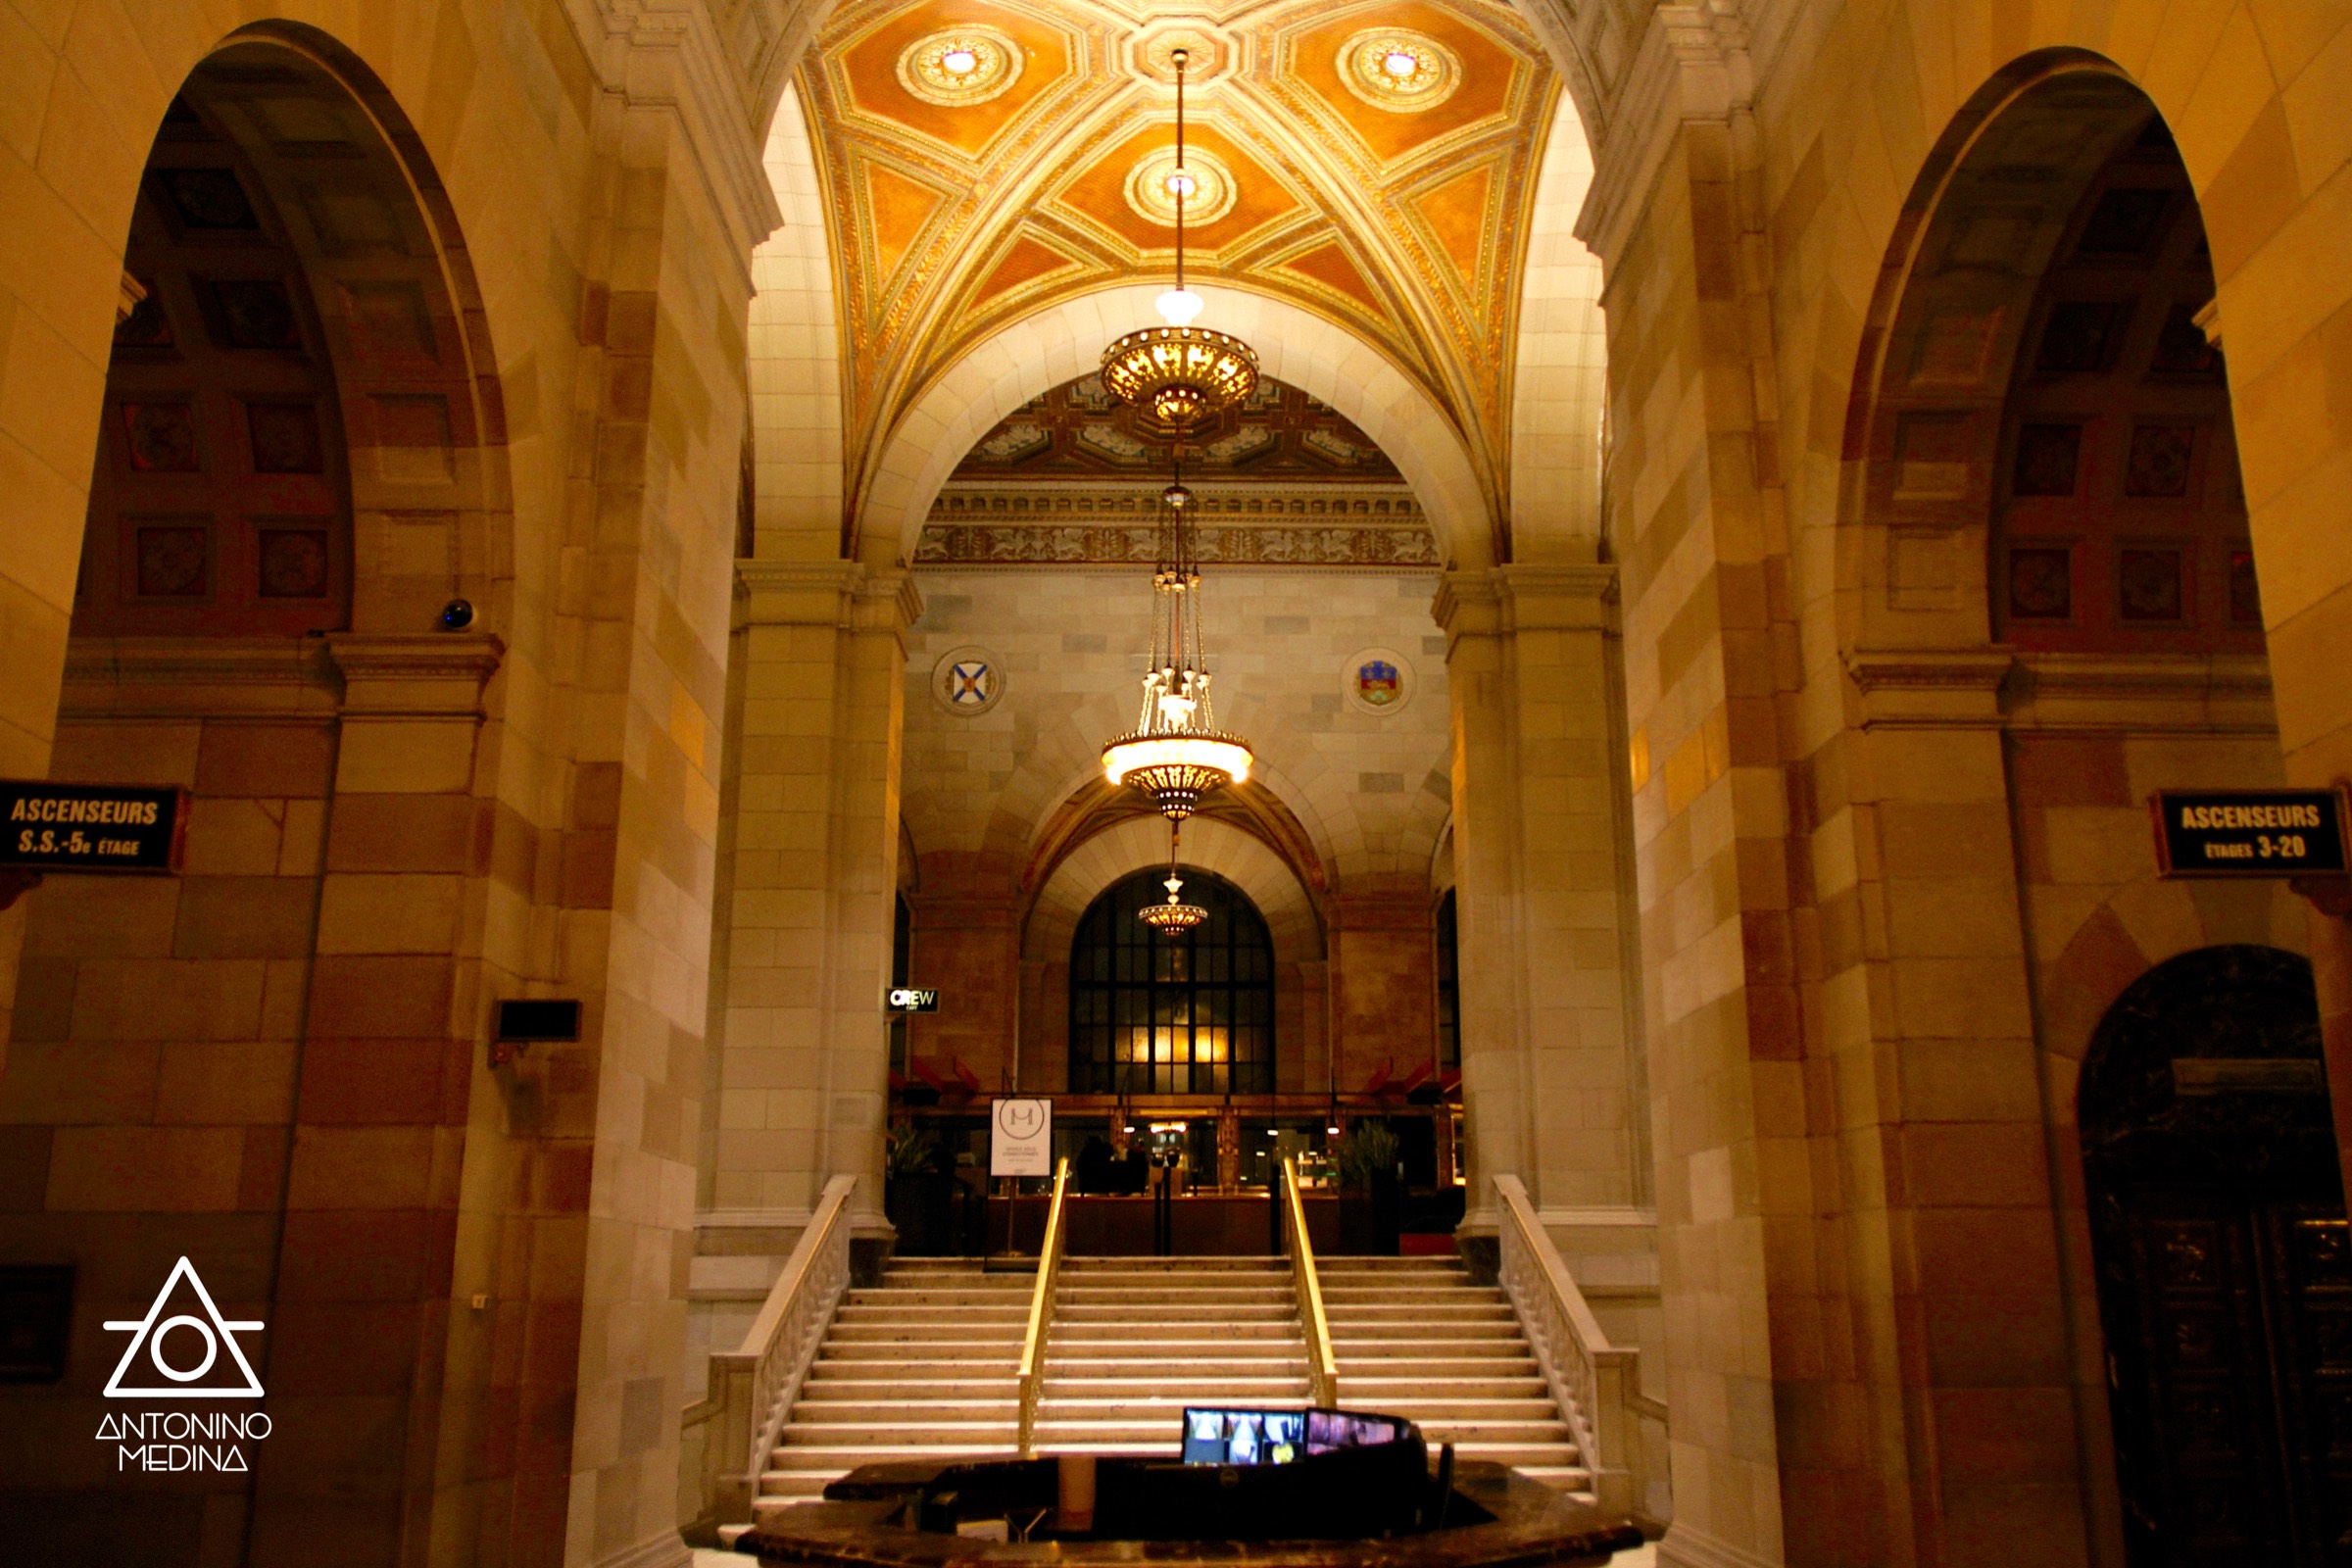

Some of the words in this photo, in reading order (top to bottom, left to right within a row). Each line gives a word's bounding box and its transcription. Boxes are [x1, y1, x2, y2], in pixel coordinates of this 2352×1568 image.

[11, 799, 158, 824] ASCENSEURS
[2181, 805, 2321, 828] ASCENSEURS
[2257, 836, 2306, 858] 3-20
[890, 990, 934, 1005] CREW
